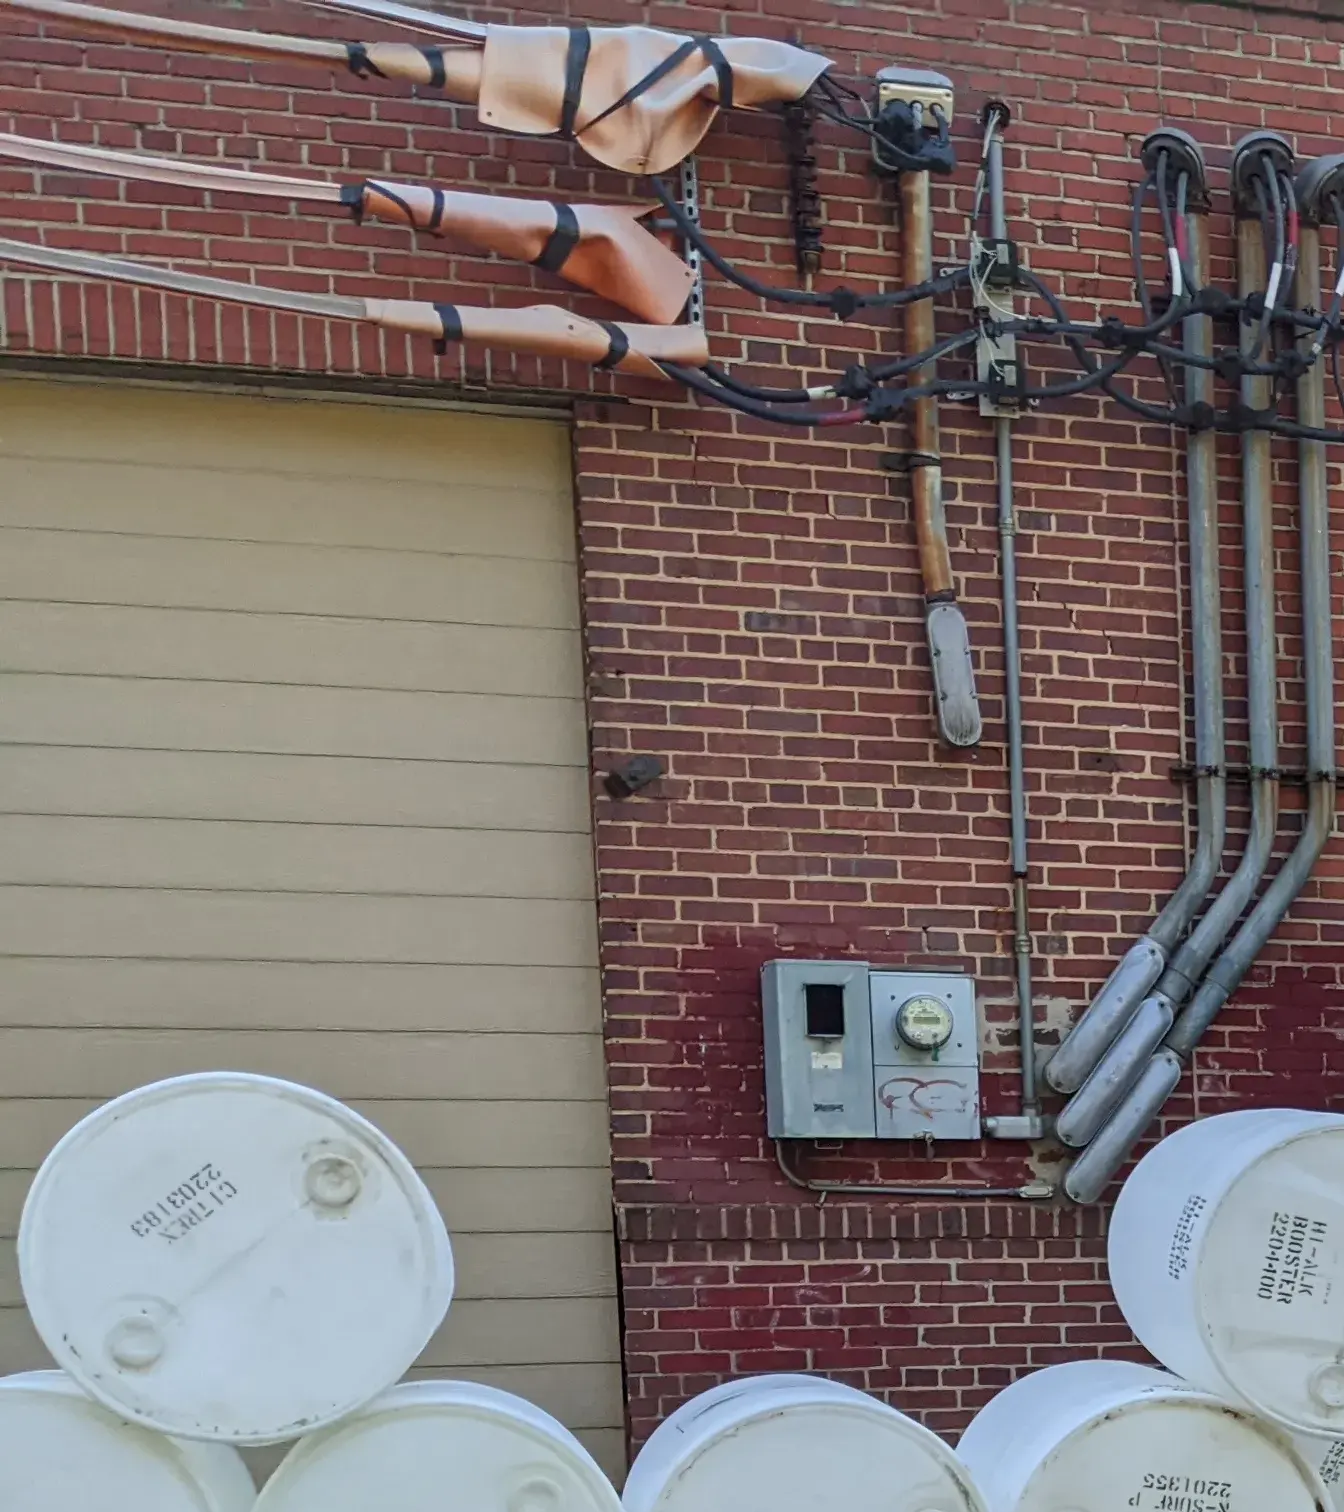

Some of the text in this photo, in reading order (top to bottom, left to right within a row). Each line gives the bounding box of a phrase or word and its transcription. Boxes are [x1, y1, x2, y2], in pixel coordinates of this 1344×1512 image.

[130, 1163, 221, 1238] 2203183
[158, 1180, 238, 1245] CITREX
[1256, 1212, 1281, 1301] 2204400
[1276, 1214, 1309, 1306] BOOSTER
[1303, 1220, 1328, 1297] HI-ALK
[1143, 1473, 1231, 1498] 2201355
